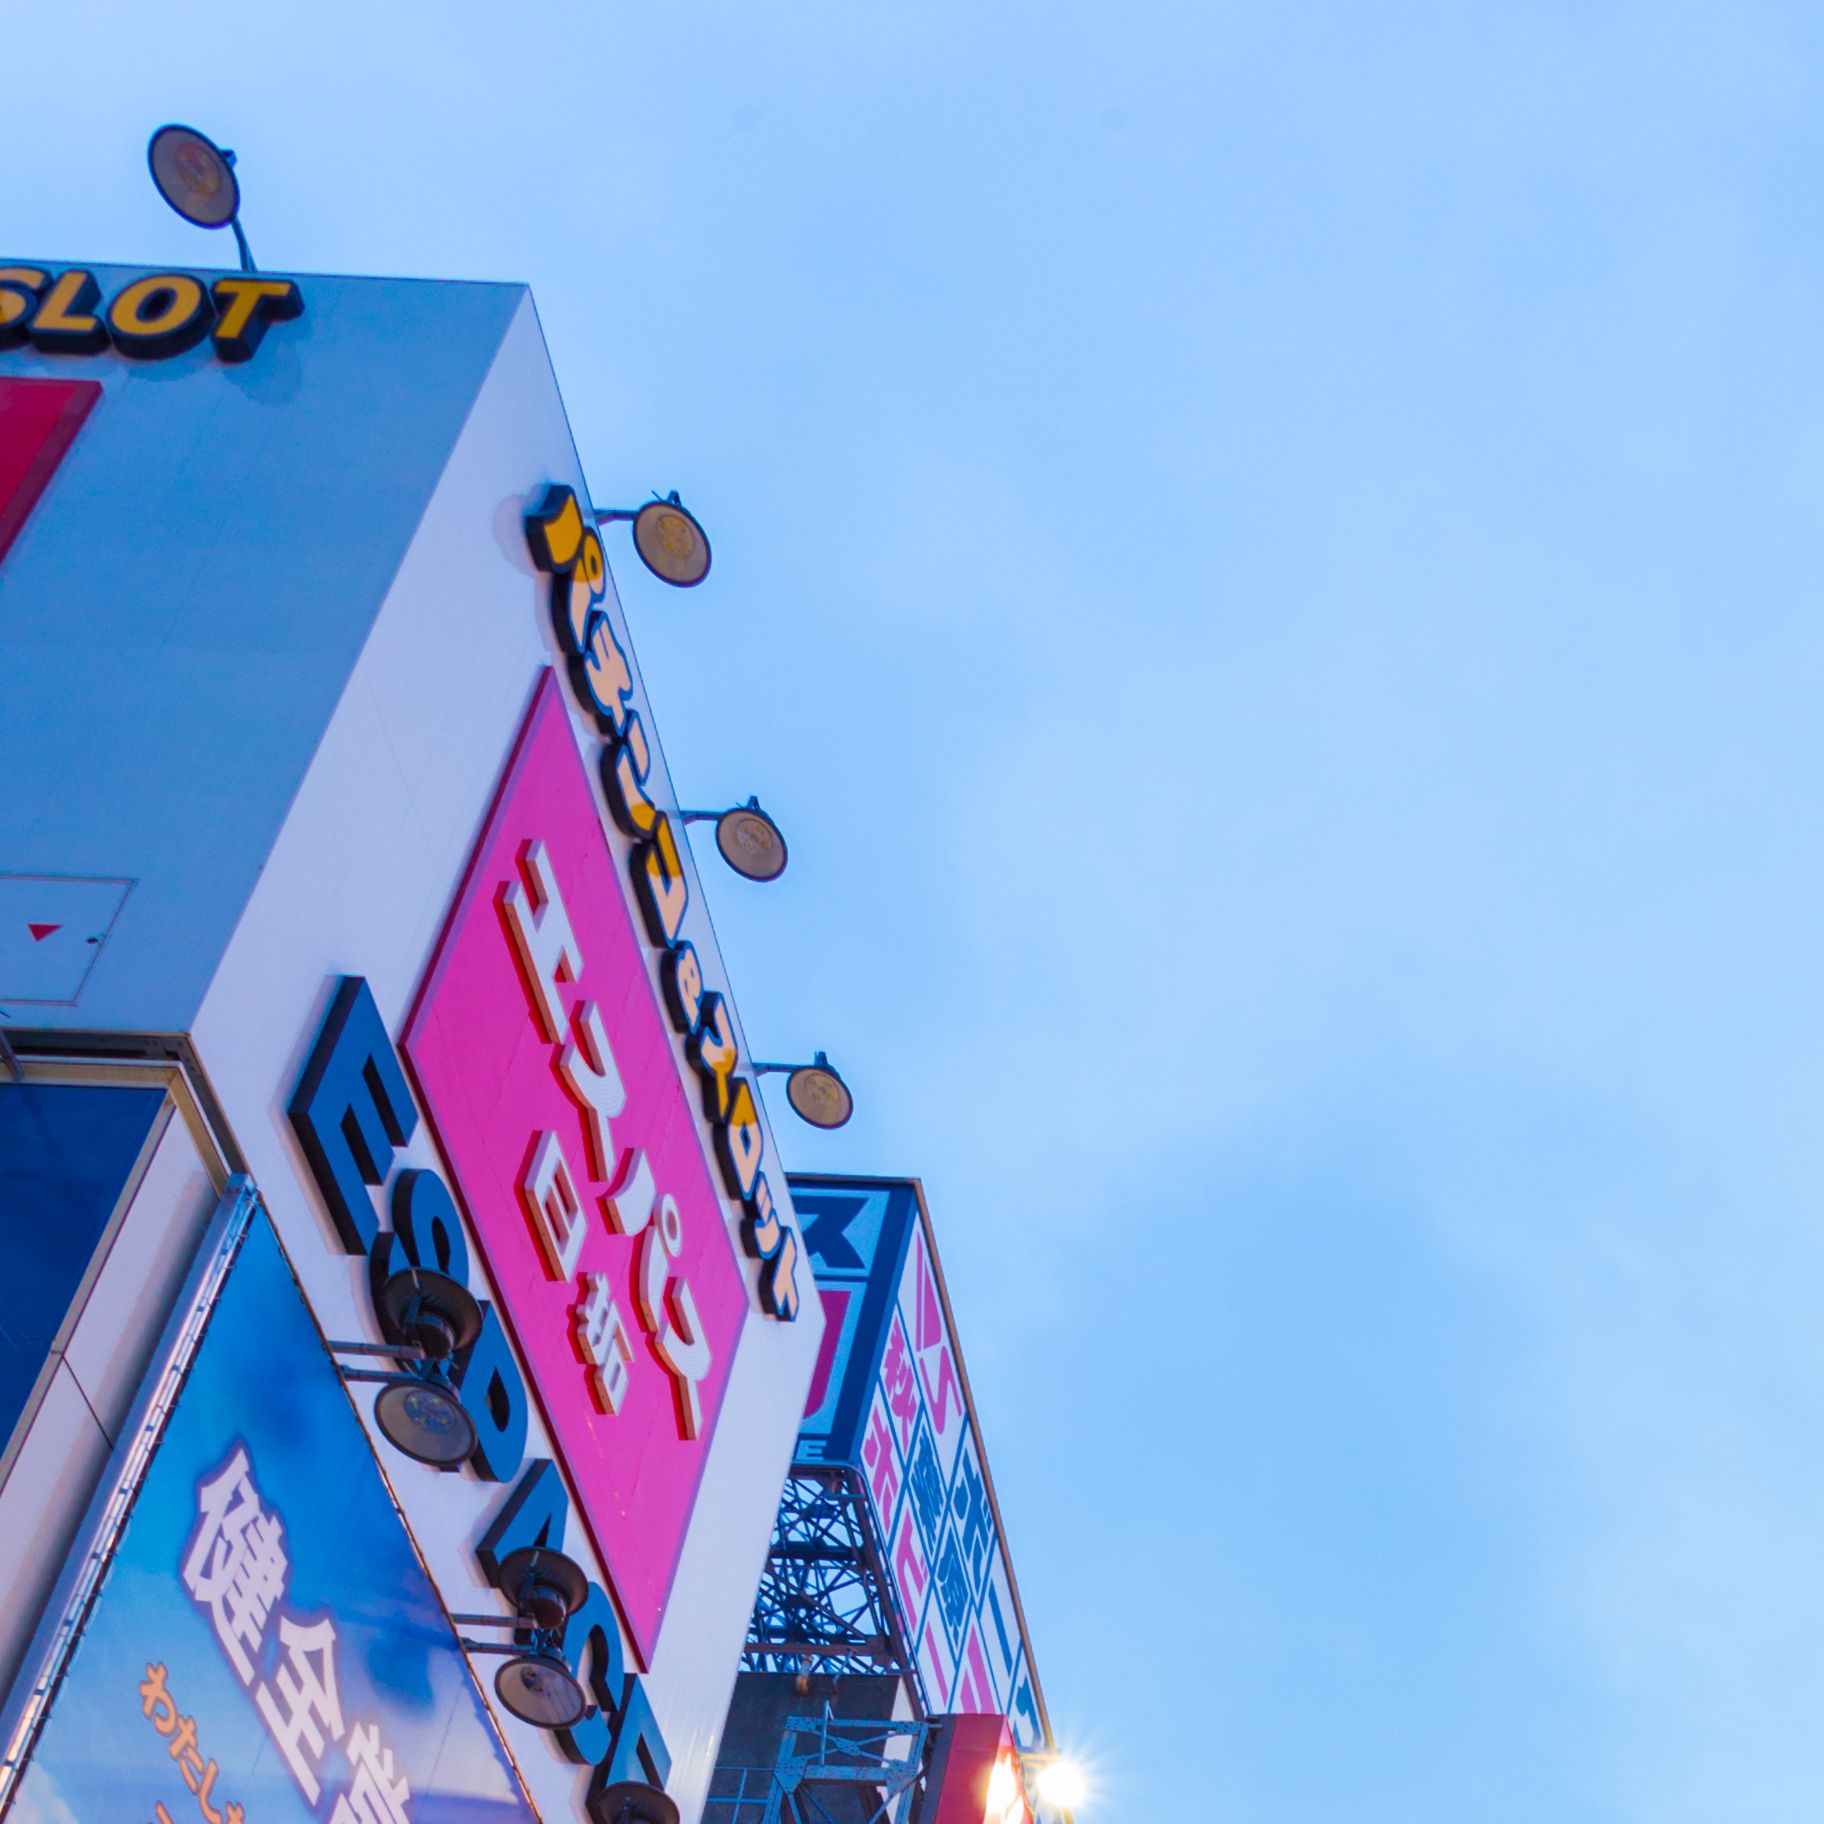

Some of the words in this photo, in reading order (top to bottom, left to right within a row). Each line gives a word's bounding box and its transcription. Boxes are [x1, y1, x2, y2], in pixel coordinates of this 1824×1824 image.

[0, 267, 304, 362] SLOT
[497, 838, 713, 1440] エスパス
[524, 1130, 632, 1414] 日拓
